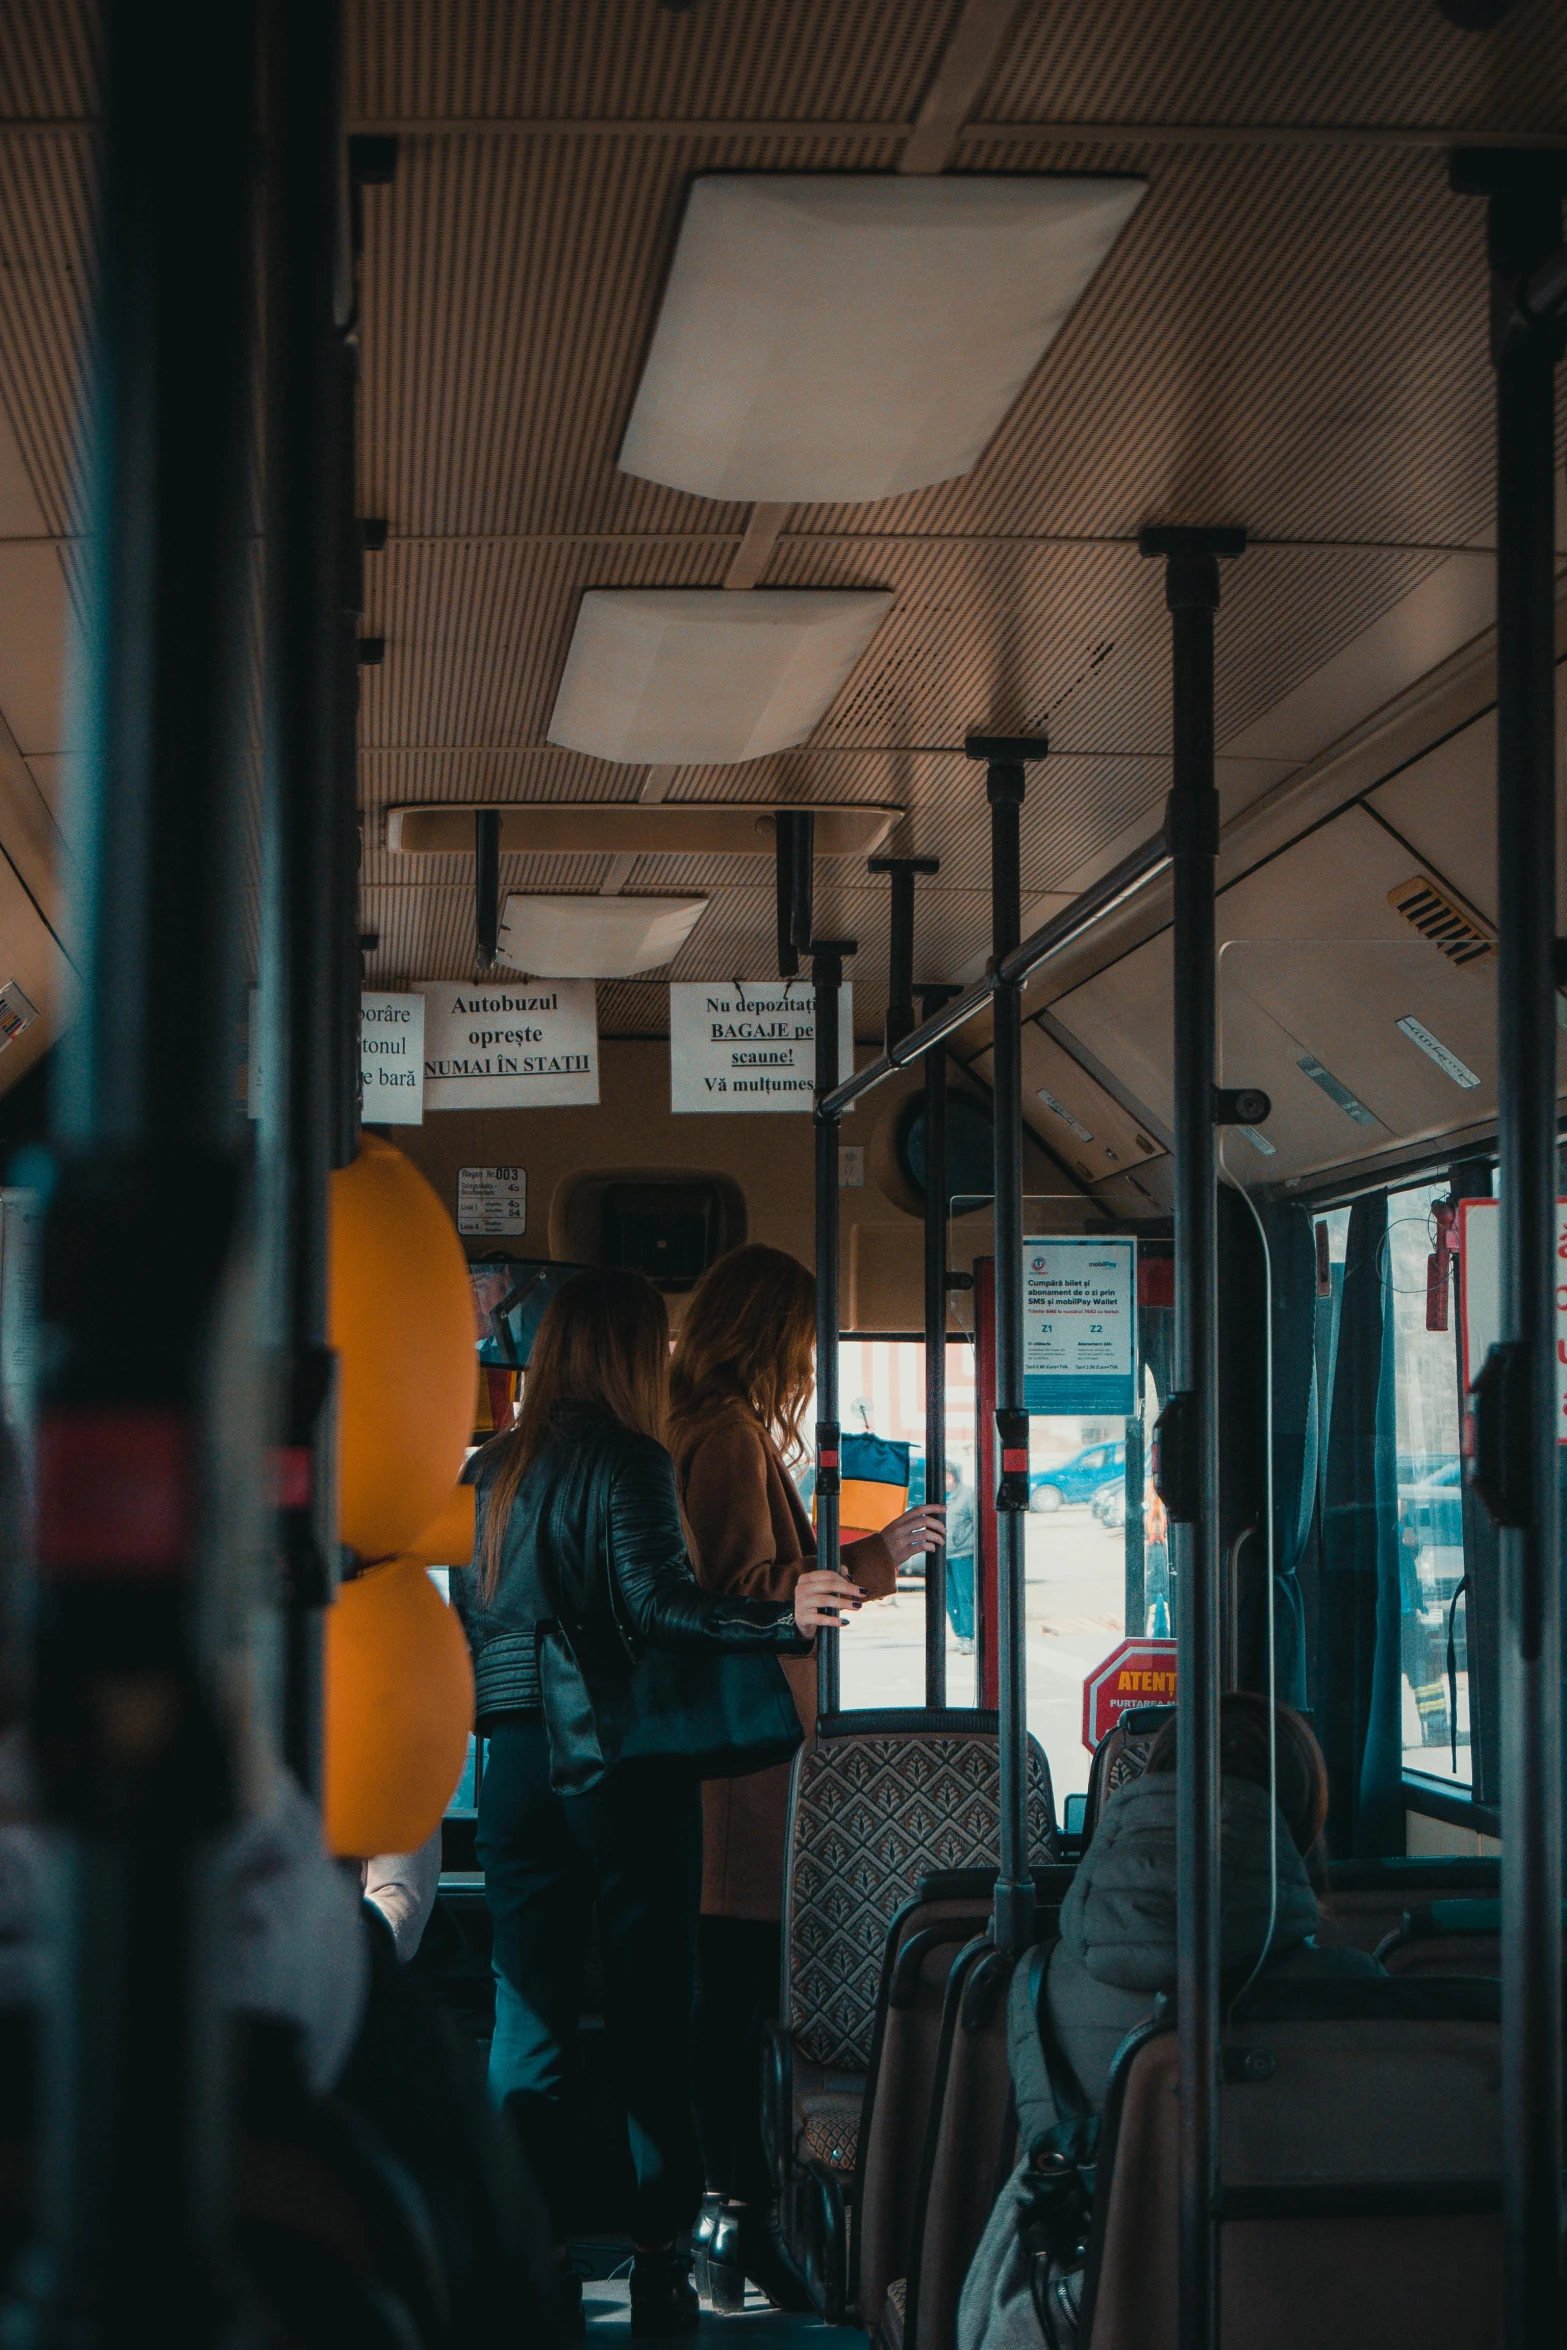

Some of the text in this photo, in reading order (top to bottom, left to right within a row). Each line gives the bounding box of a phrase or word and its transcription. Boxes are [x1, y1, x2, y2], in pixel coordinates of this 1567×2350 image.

[451, 994, 558, 1014] Autobuzul
[706, 998, 730, 1013] Nu
[469, 1027, 542, 1048] oprește
[711, 1023, 814, 1041] BAGAJE pe
[362, 1037, 406, 1055] tonul
[732, 1049, 793, 1063] scaune!
[424, 1058, 491, 1076] NUMAI
[497, 1054, 518, 1073] ÎN
[379, 1068, 415, 1087] bară
[704, 1077, 727, 1092] Vă
[496, 1168, 518, 1180] 003
[509, 1209, 520, 1217] 54
[1028, 1279, 1091, 1289] Cumpără bilet și
[1100, 1289, 1115, 1297] prin
[1028, 1298, 1118, 1308] SMS și mobilPay Wallet
[1042, 1324, 1052, 1333] Z1
[1090, 1324, 1103, 1333] Z2
